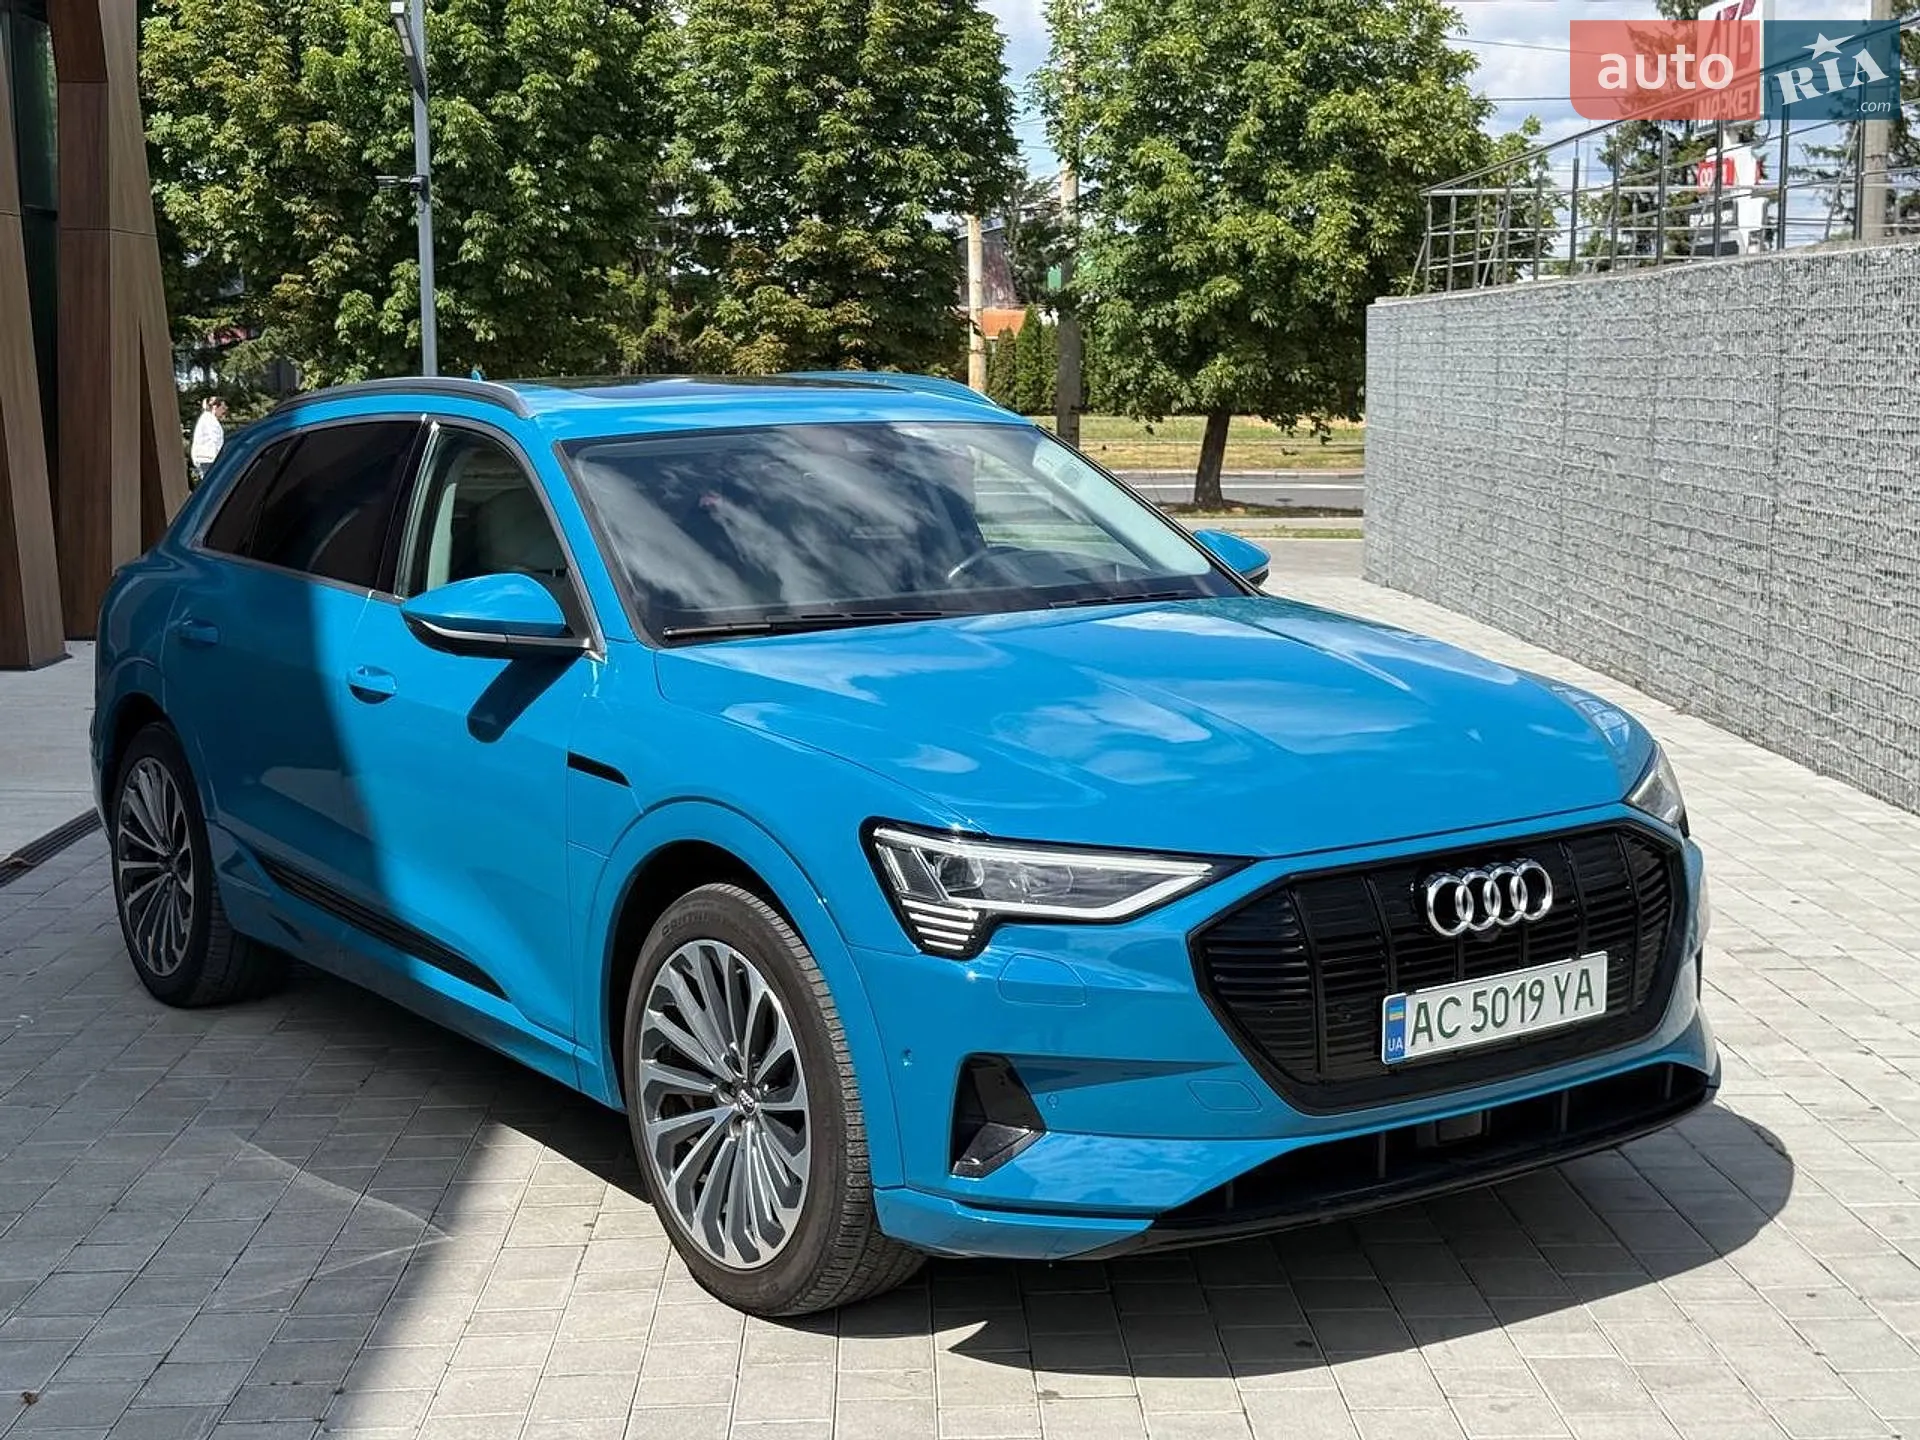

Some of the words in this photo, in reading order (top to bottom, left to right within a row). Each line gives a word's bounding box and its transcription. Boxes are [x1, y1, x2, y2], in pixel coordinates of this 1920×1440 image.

[1410, 996, 1462, 1046] AC
[1470, 978, 1545, 1033] 5019
[1554, 968, 1594, 1015] YA
[1387, 1038, 1404, 1052] UA
